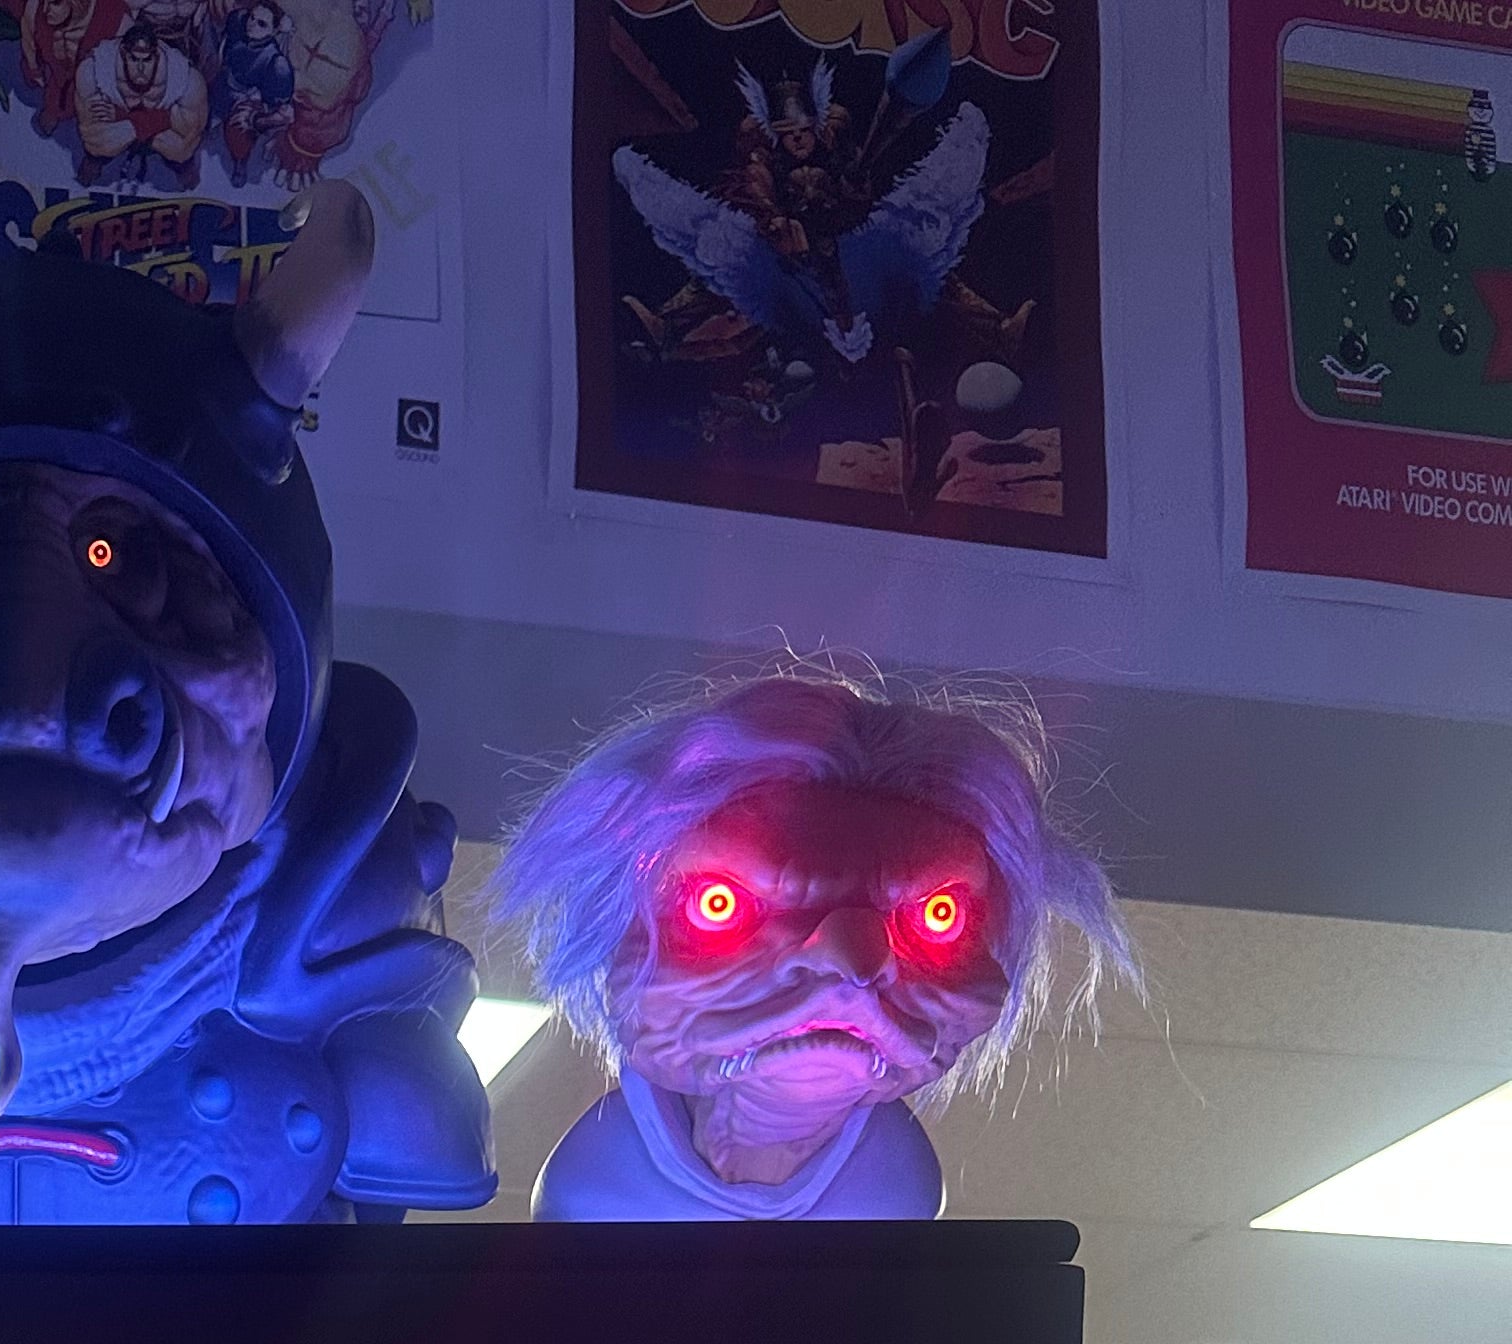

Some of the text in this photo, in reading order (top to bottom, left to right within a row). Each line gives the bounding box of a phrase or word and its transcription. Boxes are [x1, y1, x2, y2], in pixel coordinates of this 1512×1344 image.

[1415, 0, 1482, 25] GAME
[1407, 464, 1448, 489] FOR
[1451, 471, 1487, 494] USE
[1337, 485, 1391, 512] ATARI
[1401, 492, 1461, 520] VIDEO
